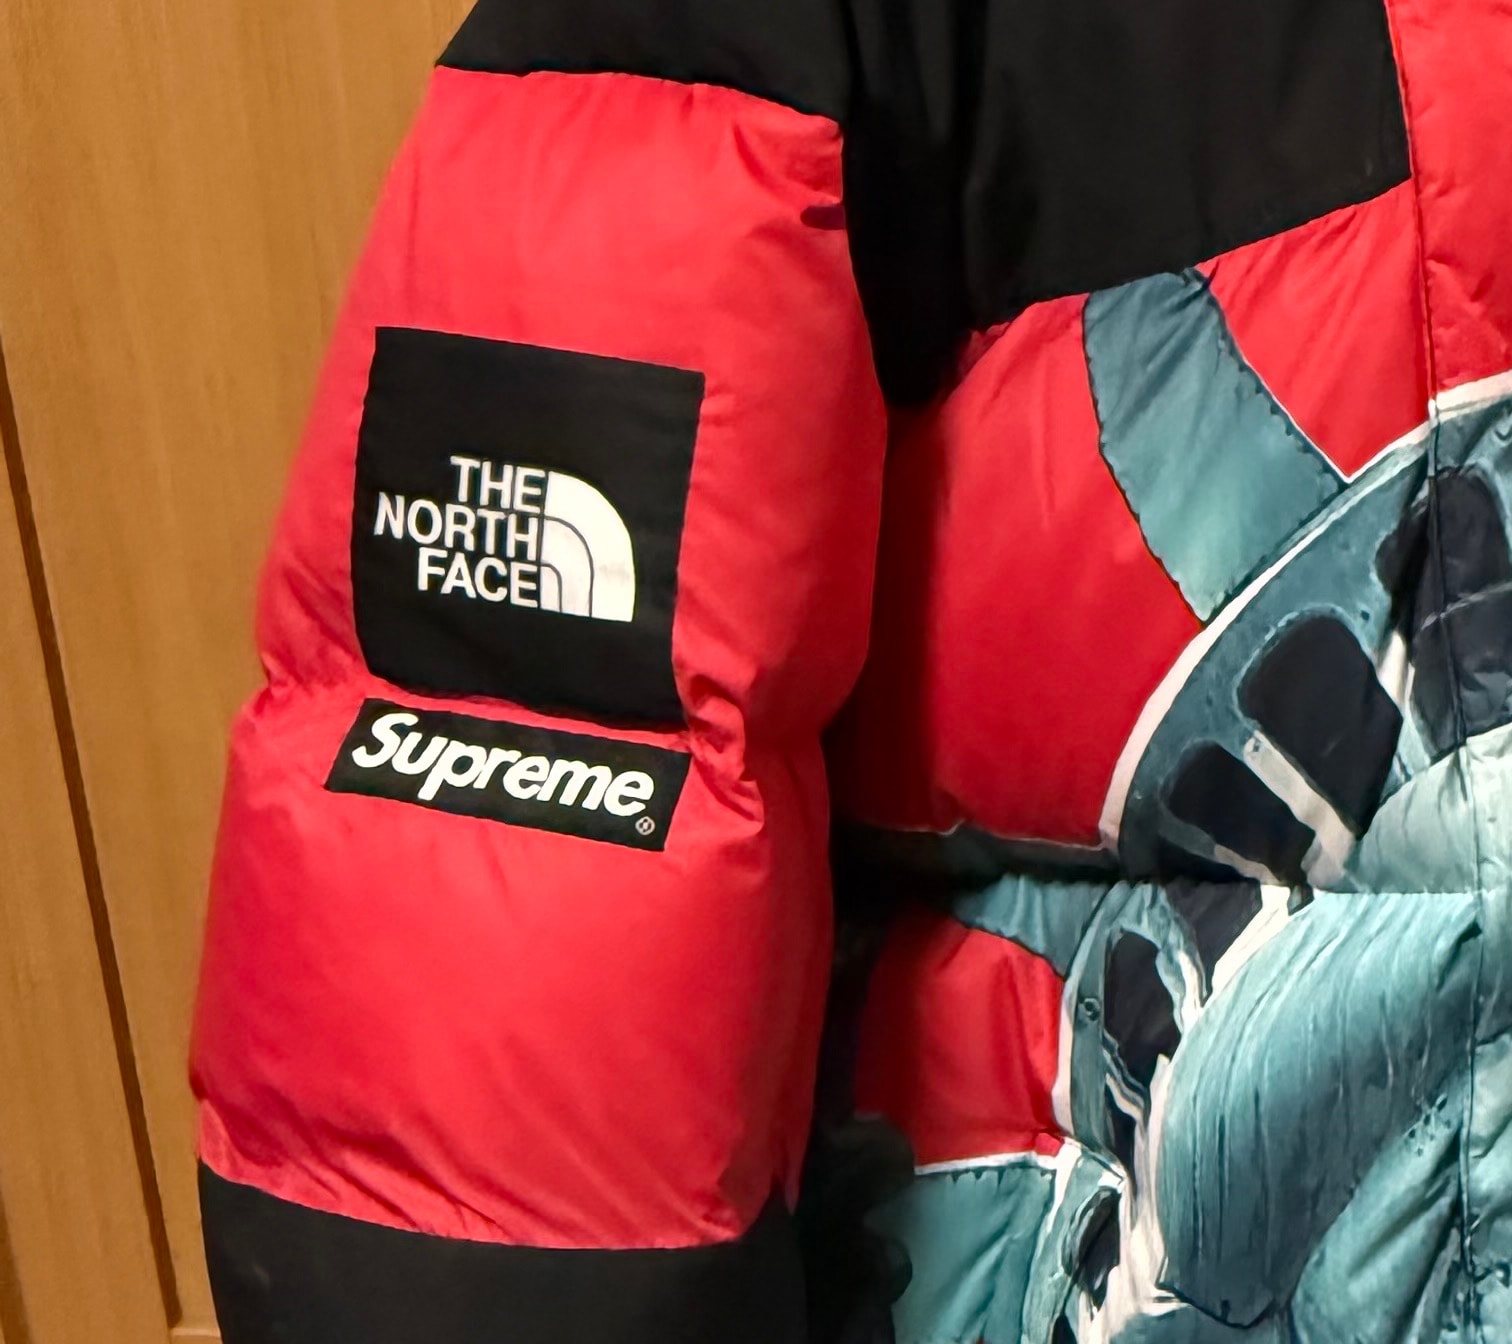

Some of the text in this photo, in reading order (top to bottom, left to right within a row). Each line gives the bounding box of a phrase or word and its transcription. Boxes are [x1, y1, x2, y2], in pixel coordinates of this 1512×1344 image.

[450, 455, 547, 514] THE
[374, 491, 540, 561] NORTH
[417, 547, 540, 609] FACE
[351, 712, 656, 818] Supreme
